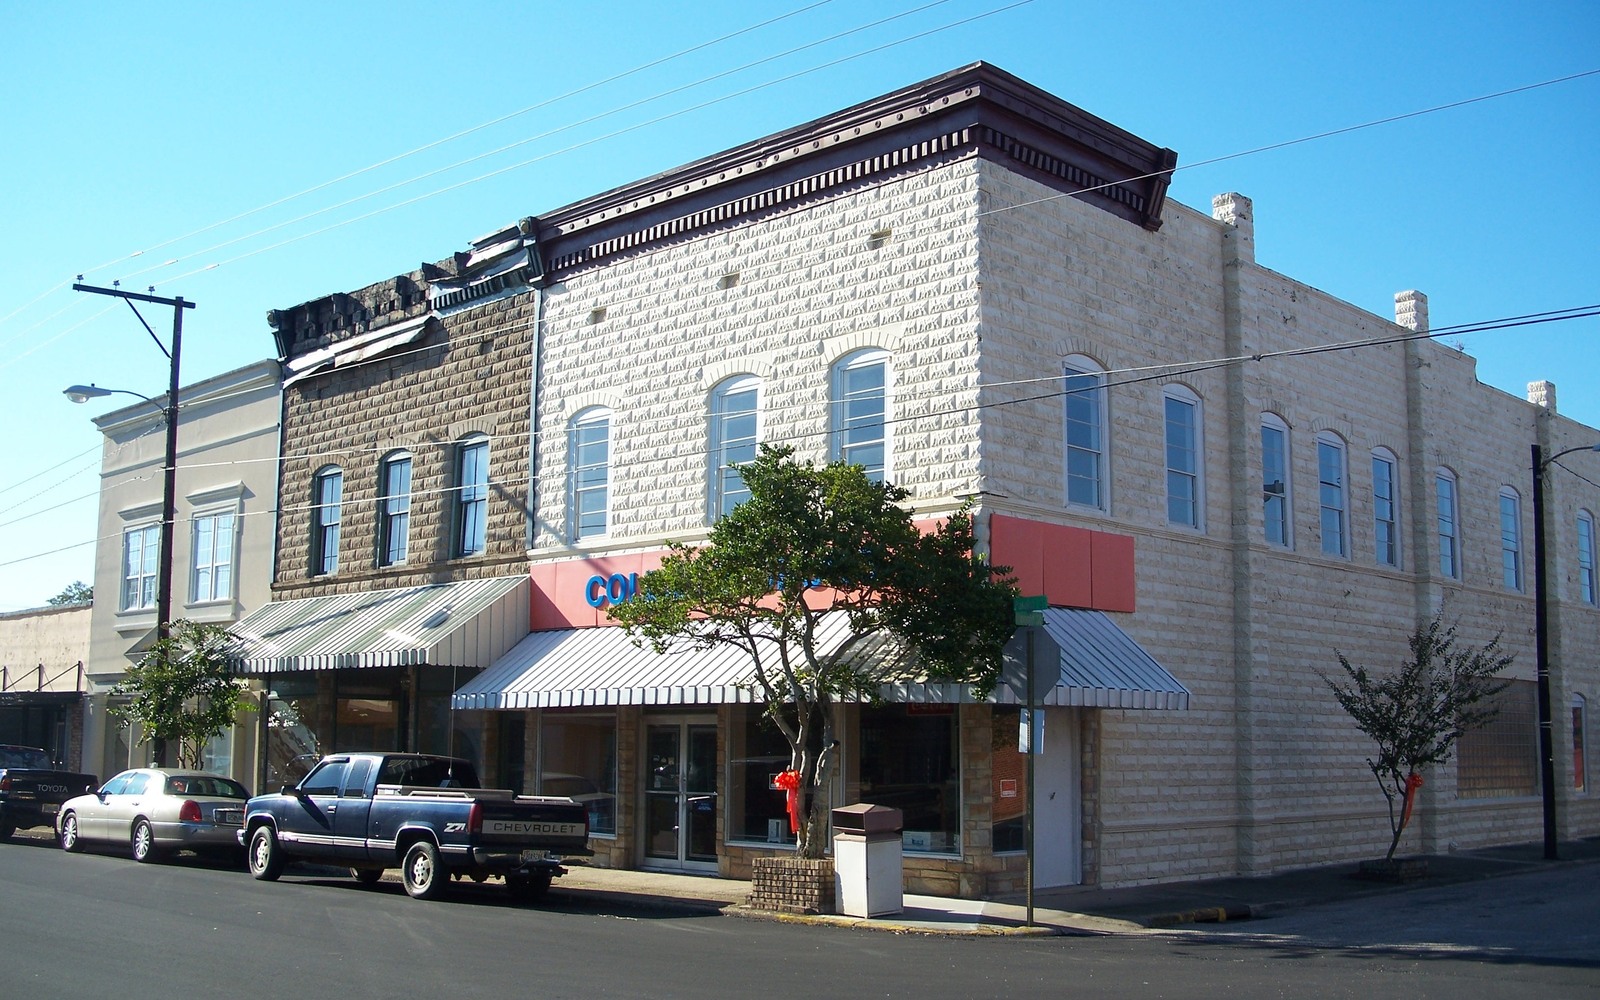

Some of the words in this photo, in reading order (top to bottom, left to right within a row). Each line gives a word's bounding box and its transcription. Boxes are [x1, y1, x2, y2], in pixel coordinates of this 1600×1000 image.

[37, 784, 69, 793] TOYOTA
[443, 822, 466, 833] Z71
[494, 822, 577, 834] CHEVROLET
